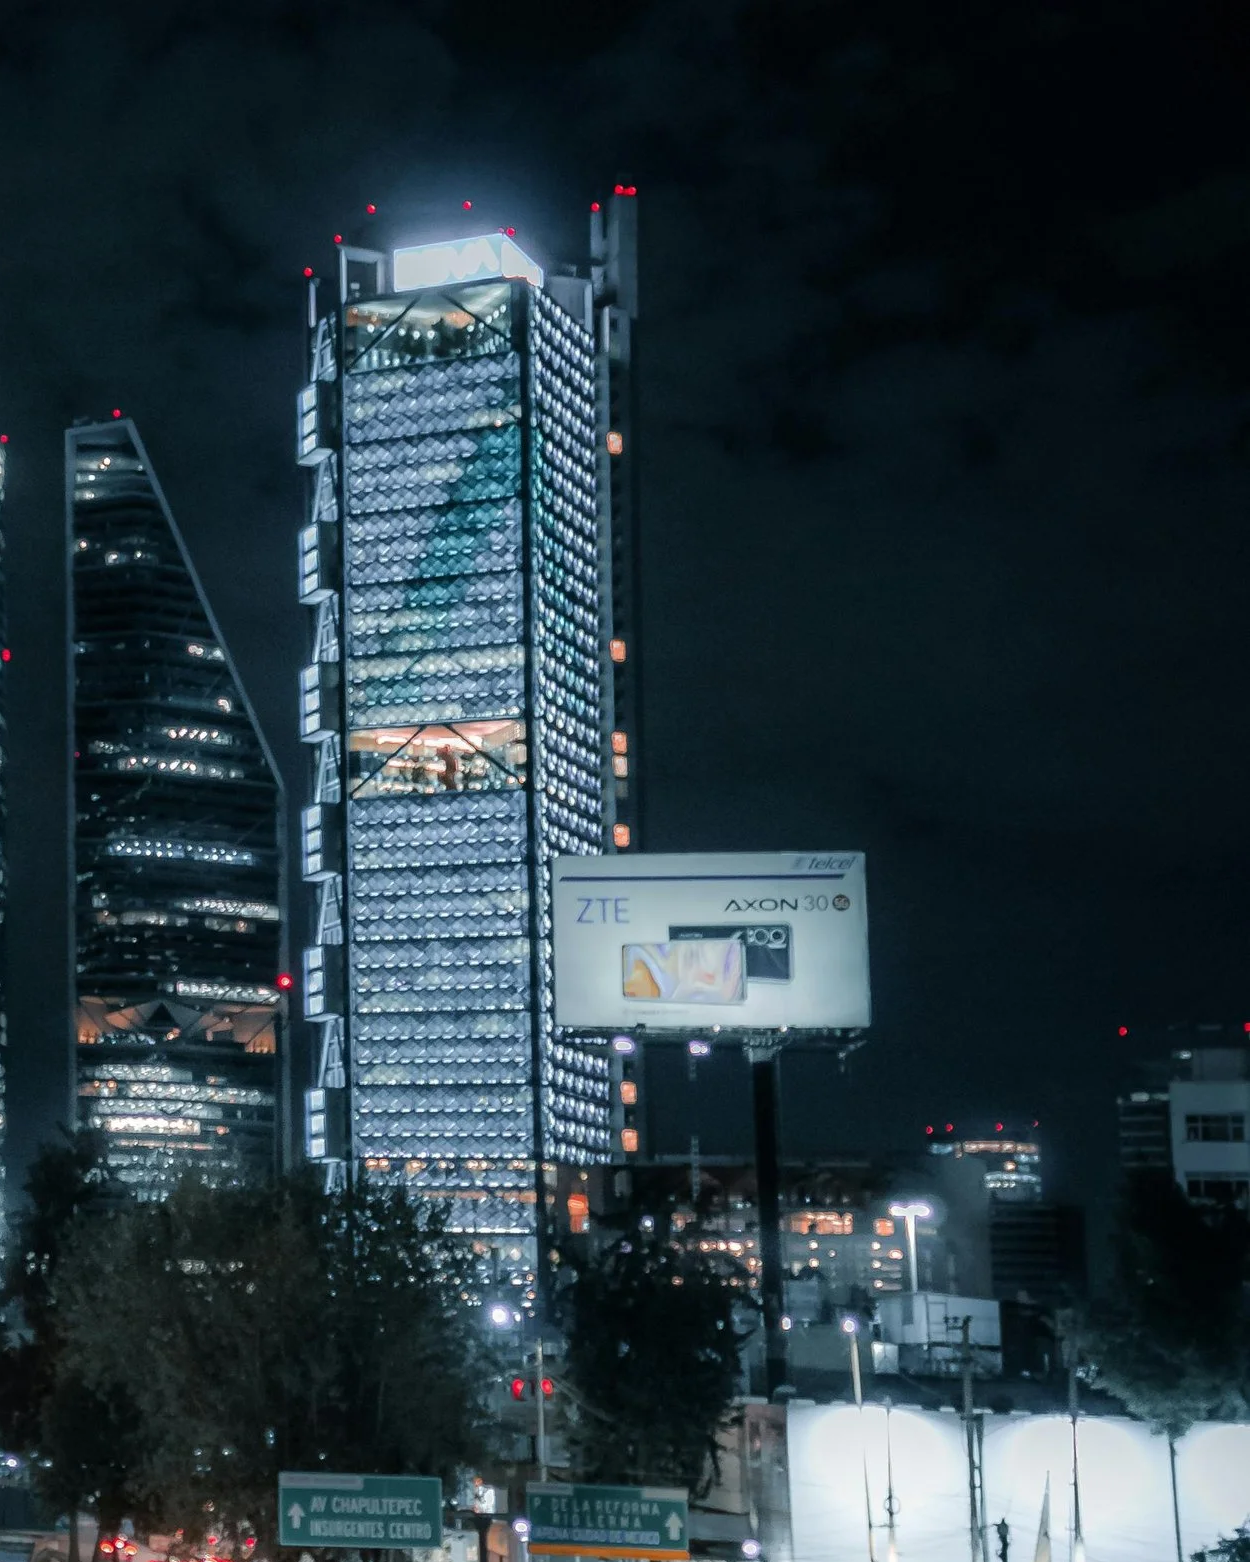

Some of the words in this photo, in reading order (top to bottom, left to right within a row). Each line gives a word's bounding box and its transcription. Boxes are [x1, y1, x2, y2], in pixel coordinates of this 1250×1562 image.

[576, 898, 630, 923] ZTE
[724, 898, 798, 912] AXON
[803, 894, 829, 911] 30
[310, 1496, 327, 1513] AV
[331, 1497, 423, 1516] CHAPULTEPEC
[551, 1498, 568, 1512] DE
[573, 1500, 591, 1513] LA
[595, 1500, 661, 1516] REFORMA
[309, 1519, 385, 1539] INSURGENTES
[388, 1521, 432, 1540] CENTRO
[552, 1512, 581, 1527] RIO
[585, 1514, 642, 1529] LERMA
